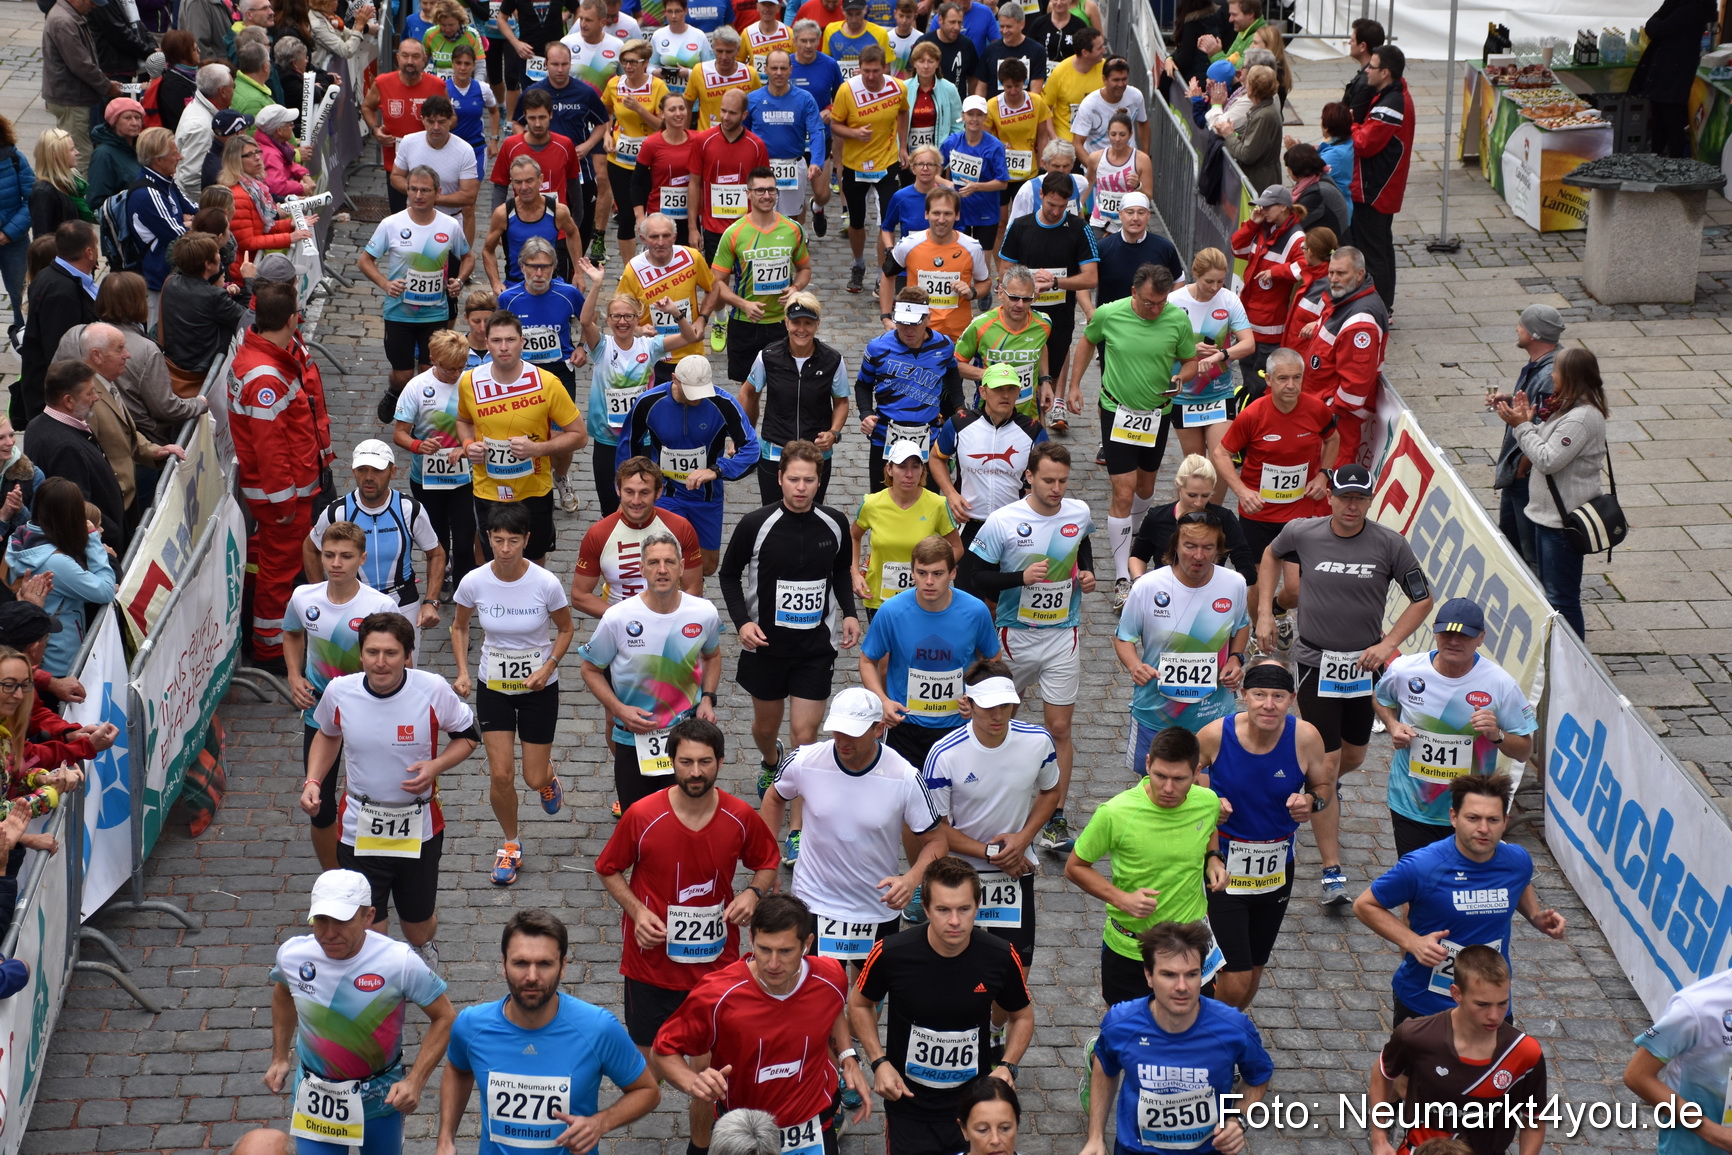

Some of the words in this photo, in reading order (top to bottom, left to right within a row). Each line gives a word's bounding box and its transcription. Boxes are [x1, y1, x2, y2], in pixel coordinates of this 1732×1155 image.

[762, 111, 794, 120] HUBER
[858, 106, 879, 118] MAX
[1000, 118, 1016, 126] MAX
[950, 159, 978, 176] 2786
[664, 194, 687, 208] 259
[718, 194, 740, 206] 157
[743, 246, 792, 260] BOCK
[758, 266, 788, 282] 2770
[410, 279, 441, 293] 2815
[645, 284, 670, 300] MAX
[672, 269, 697, 287] BÖGL
[926, 280, 951, 294] 346
[523, 335, 556, 350] 2608
[987, 349, 1041, 362] BOCK
[886, 358, 940, 390] TEAM
[477, 404, 508, 418] MAX
[512, 394, 546, 411] BÖGL
[1123, 414, 1152, 432] 220
[1127, 432, 1142, 441] Gerd
[494, 465, 524, 474] Christian
[670, 458, 699, 472] 194
[1272, 475, 1300, 490] 129
[782, 592, 822, 611] 2355
[1031, 592, 1064, 609] 238
[506, 607, 540, 616] NEUMARKT
[786, 614, 818, 622] Sebastian
[1033, 611, 1057, 620] Florian
[916, 648, 952, 661] RUN
[498, 661, 532, 679] 125
[910, 672, 928, 681] PARTL
[1164, 665, 1212, 684] 2642
[920, 682, 954, 700] 204
[1175, 688, 1199, 697] Achim
[1334, 683, 1359, 691] Helmut
[1408, 694, 1424, 702] PARTL
[1469, 694, 1488, 703] Hervis
[924, 702, 947, 712] Julian
[1432, 737, 1462, 746] Neumarkt
[1422, 744, 1458, 766] 341
[1420, 766, 1458, 778] Karlheinz
[360, 807, 382, 816] PARTL
[383, 810, 414, 818] Neumarkt
[371, 817, 410, 837] 514
[1242, 854, 1278, 874] 116
[1230, 876, 1281, 888] Hans-Werner
[689, 886, 705, 896] DEHN
[1452, 888, 1509, 904] HUBER
[669, 910, 692, 918] PARTL
[980, 911, 1000, 919] Felix
[674, 916, 724, 941] 2246
[683, 946, 718, 955] Andreas
[835, 941, 859, 951] Walter
[358, 978, 382, 987] Hervis
[912, 1030, 935, 1044] PARTL
[915, 1042, 974, 1067] 3046
[770, 1067, 790, 1076] DEHN
[908, 1066, 976, 1080] CHRISTOF
[1138, 1064, 1209, 1083] HUBER
[490, 1080, 516, 1089] PARTL
[518, 1082, 556, 1092] Neumarkt
[1152, 1082, 1206, 1090] TECHNOLOGY
[307, 1091, 349, 1122] 305
[496, 1092, 562, 1120] 2276
[1140, 1096, 1165, 1106] PARTL
[1166, 1094, 1202, 1105] Neumarkt
[1146, 1101, 1211, 1128] 2550
[306, 1120, 348, 1137] Christoph
[504, 1124, 551, 1139] Bernhard
[1156, 1131, 1204, 1141] Christoph
